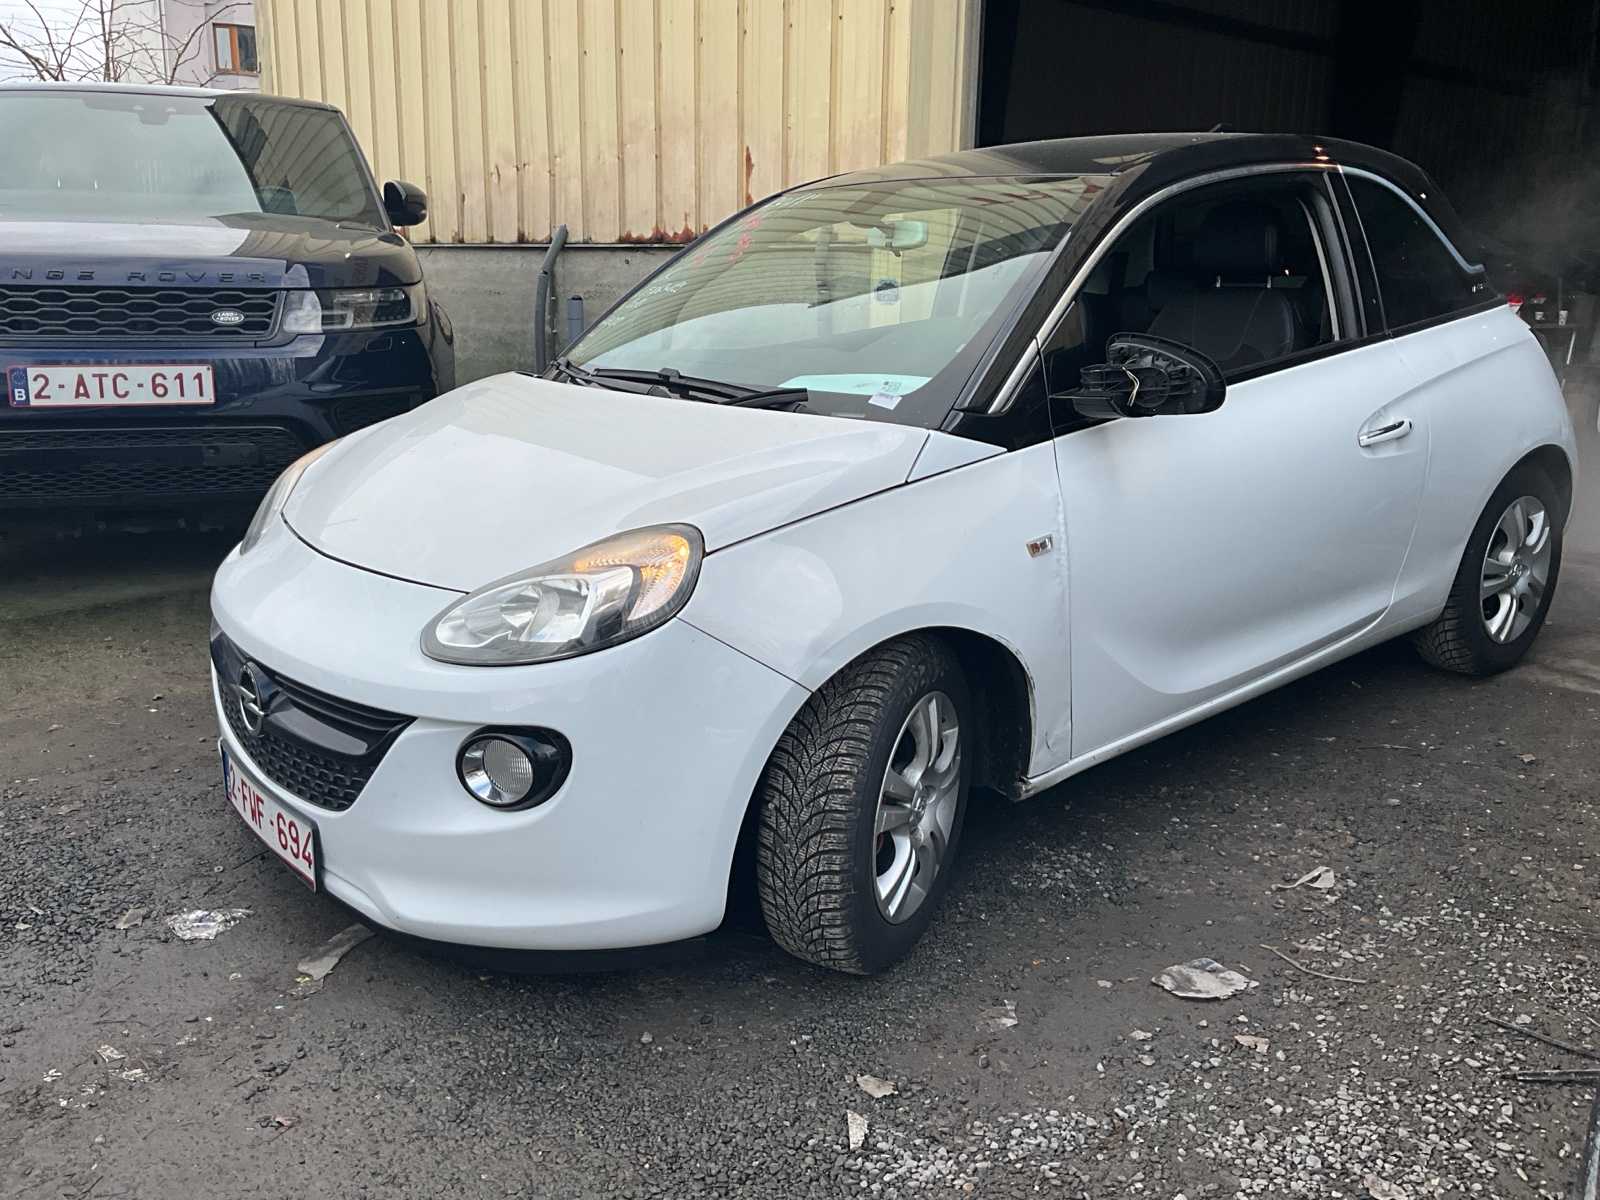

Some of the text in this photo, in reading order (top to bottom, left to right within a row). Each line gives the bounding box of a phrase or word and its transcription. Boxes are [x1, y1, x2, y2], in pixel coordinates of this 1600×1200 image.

[127, 271, 266, 283] ROVER
[14, 388, 26, 401] B
[32, 372, 204, 400] 2-ATC-611
[229, 763, 313, 870] 2-FWF-694
